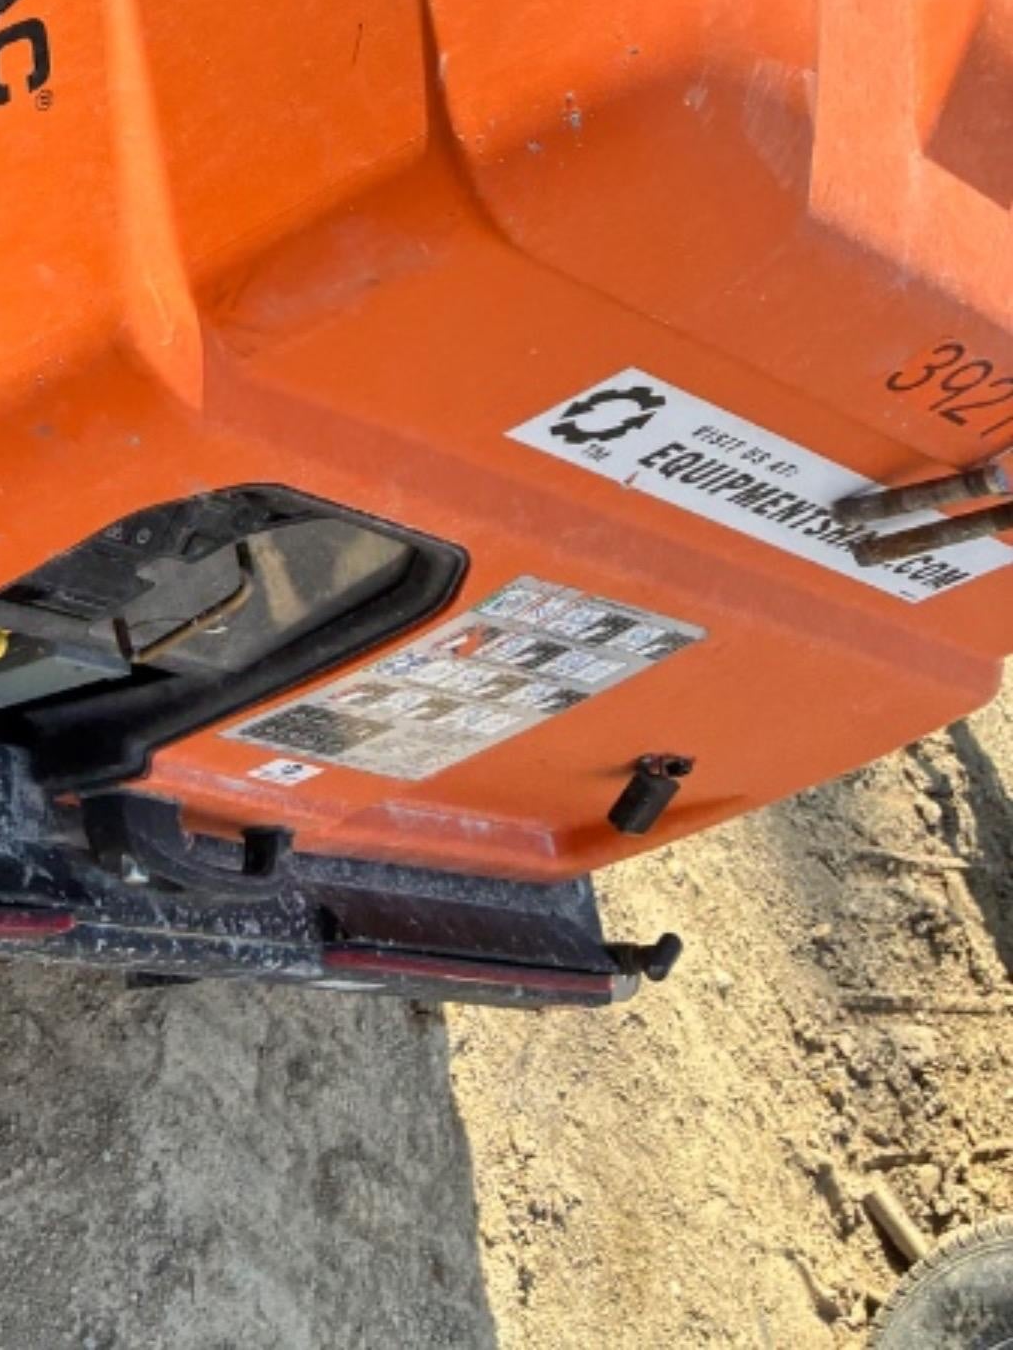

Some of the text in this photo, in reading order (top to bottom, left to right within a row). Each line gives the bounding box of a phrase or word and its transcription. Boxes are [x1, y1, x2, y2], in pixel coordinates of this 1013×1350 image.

[691, 424, 747, 453] VISIT
[739, 447, 772, 467] US
[638, 441, 971, 589] EQUIPMENTSHA.COM
